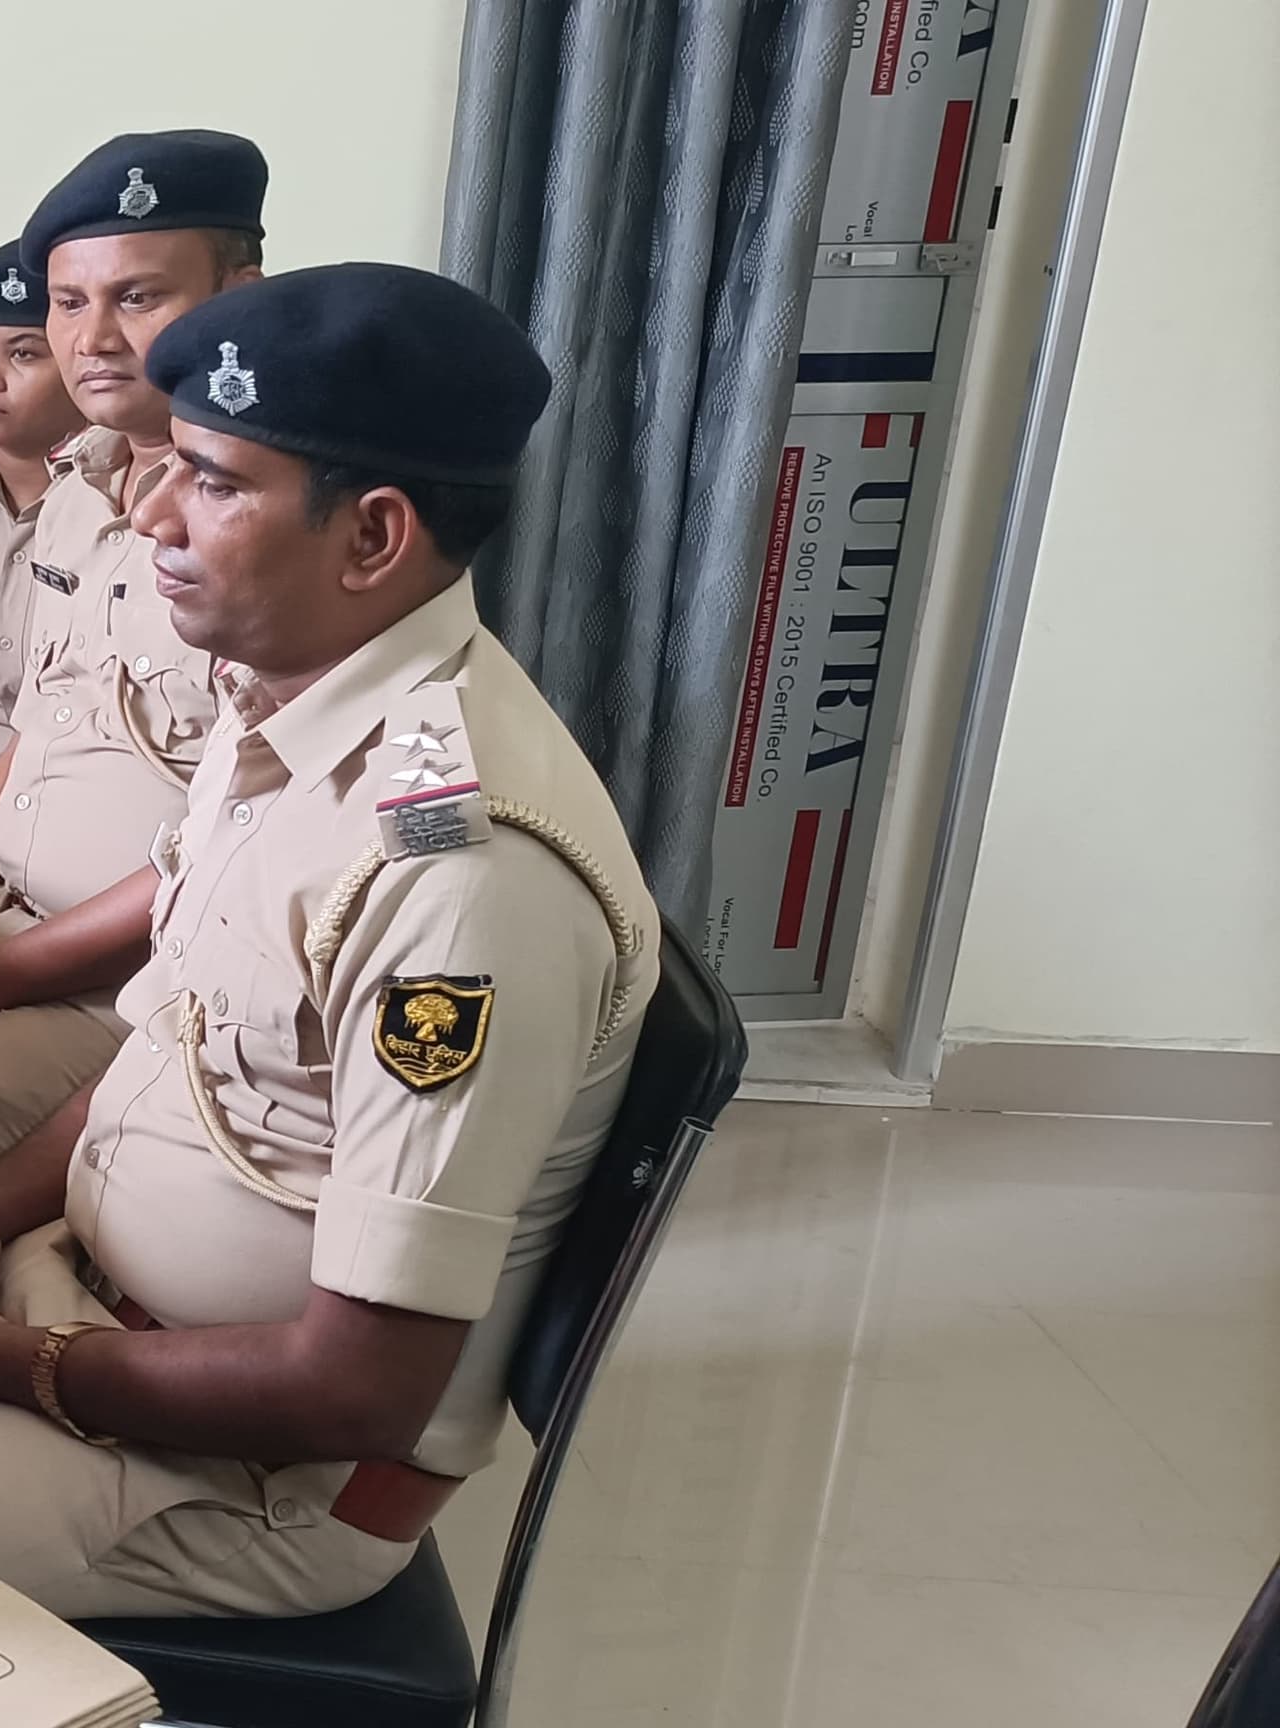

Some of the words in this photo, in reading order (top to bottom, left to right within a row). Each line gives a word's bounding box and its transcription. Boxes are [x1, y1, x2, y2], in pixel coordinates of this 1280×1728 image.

[878, 1, 903, 89] INSTALLATION
[906, 51, 929, 90] Co.
[864, 201, 879, 237] Vocal
[782, 452, 798, 500] REMOVE
[811, 453, 832, 482] An
[804, 492, 826, 534] ISO
[771, 503, 789, 572] PROTECTIVE
[793, 541, 817, 594] 9001
[766, 575, 777, 600] FILM
[758, 602, 772, 642] WITHIN
[804, 481, 912, 776] ULTRA
[755, 644, 766, 657] 45
[781, 616, 805, 668] 2015
[749, 659, 763, 687] DAYS
[744, 689, 758, 725] AFTER
[765, 676, 794, 761] Certified
[731, 727, 753, 802] INSTALLATION
[757, 768, 779, 802] Co.
[721, 897, 735, 928] Vocal
[718, 932, 728, 949] For
[713, 954, 725, 974] Loc
